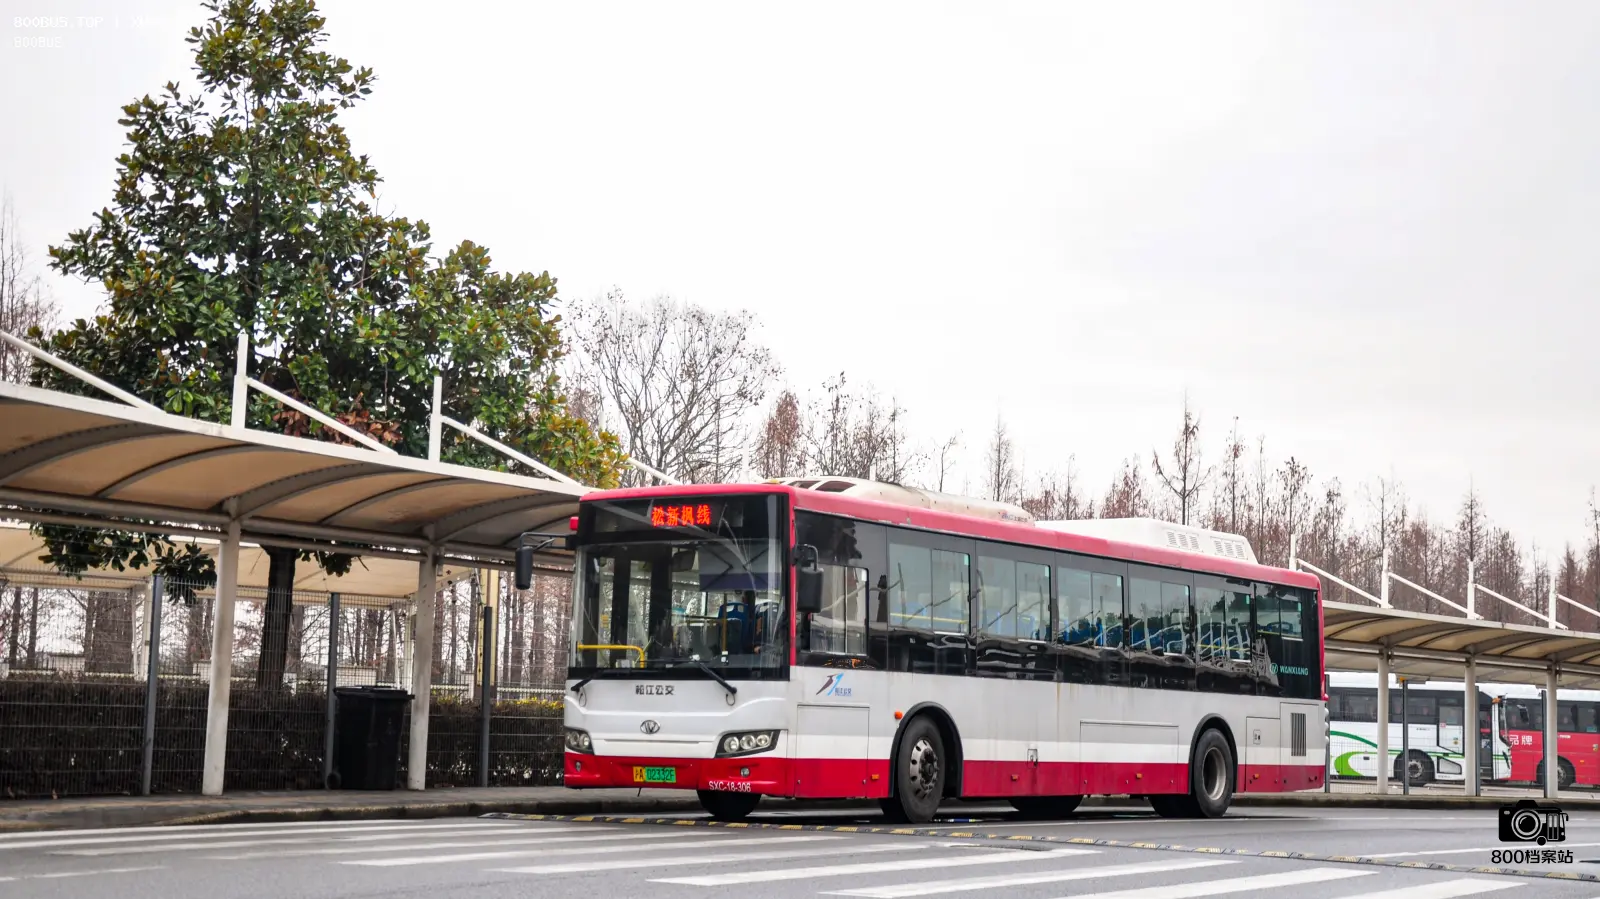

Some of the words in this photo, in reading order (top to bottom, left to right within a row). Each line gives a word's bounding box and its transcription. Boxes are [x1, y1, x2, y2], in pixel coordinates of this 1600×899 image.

[652, 504, 711, 527] 松新枫线
[708, 780, 751, 793] SXC-18-306
